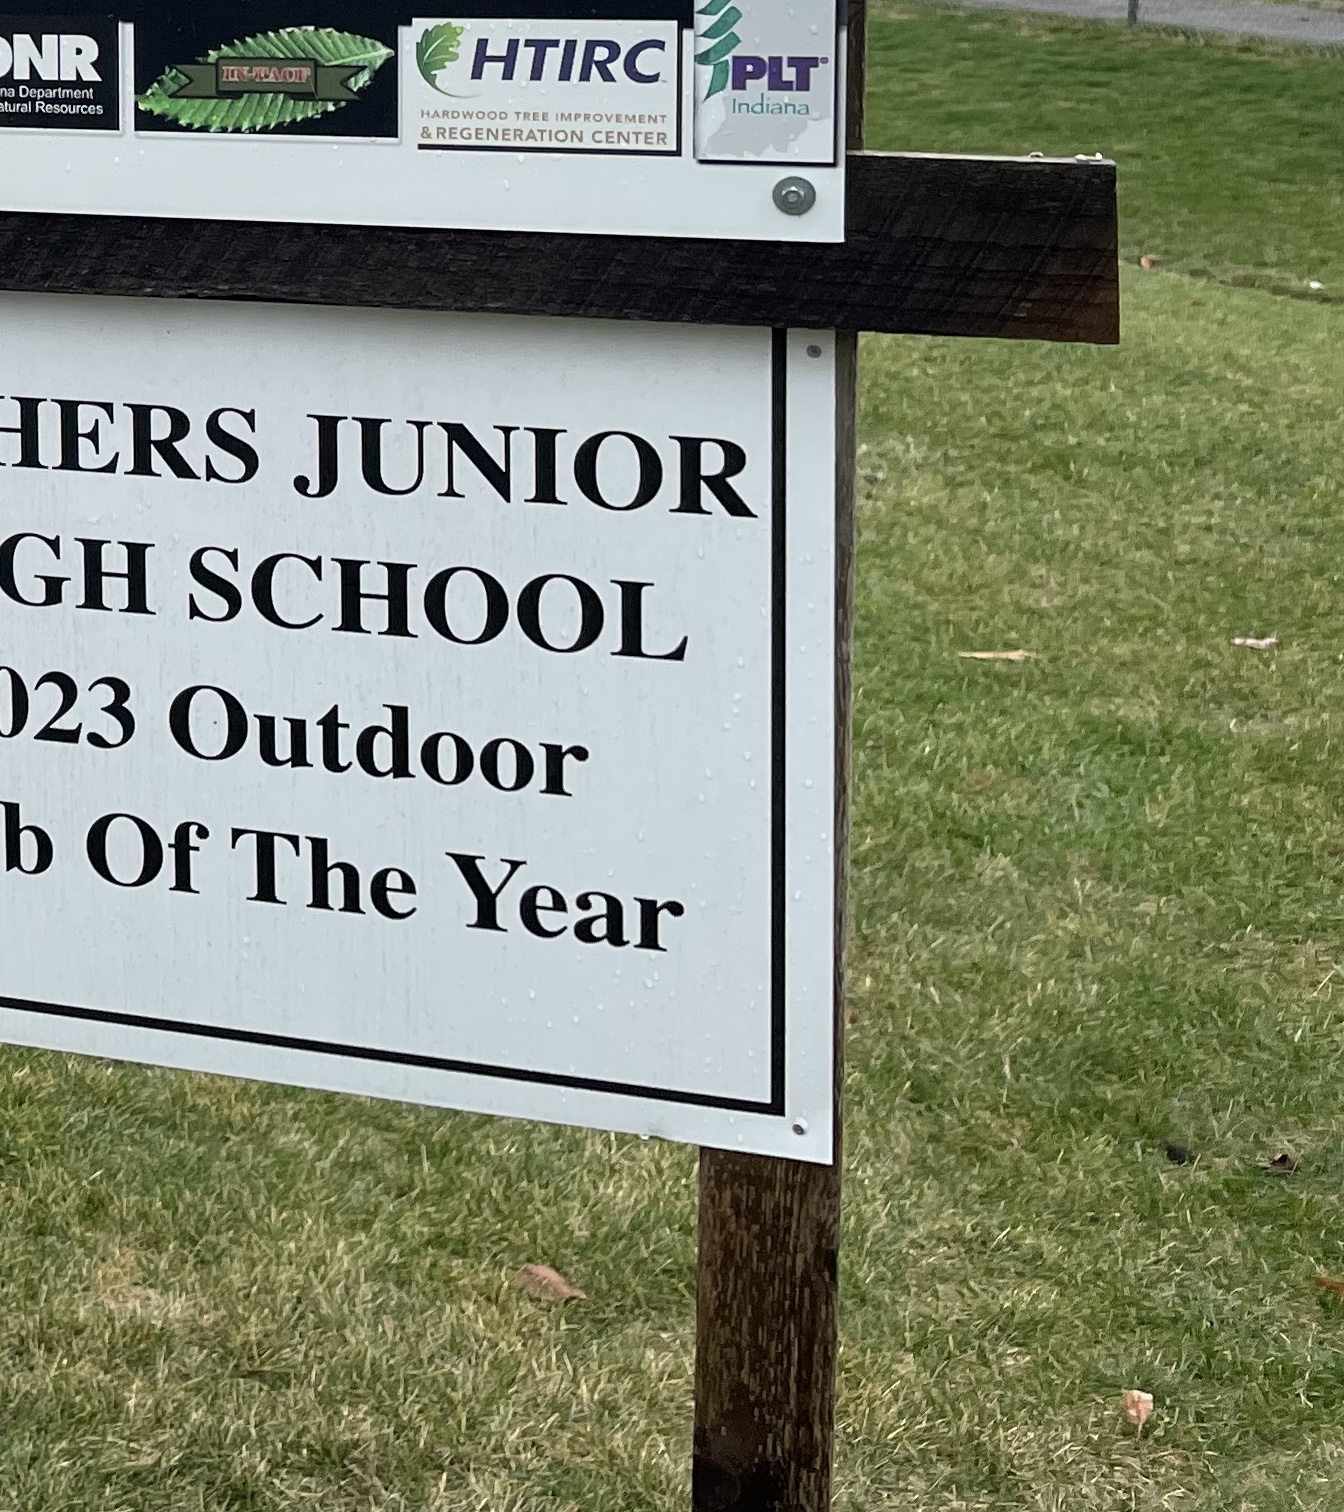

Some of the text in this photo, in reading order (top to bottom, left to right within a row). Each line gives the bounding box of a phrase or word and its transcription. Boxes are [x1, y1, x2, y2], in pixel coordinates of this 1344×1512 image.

[470, 37, 667, 84] HTIRC
[731, 55, 820, 92] PLT
[18, 85, 94, 100] Department
[34, 101, 104, 115] Resources
[732, 92, 810, 115] Indiana
[420, 109, 668, 124] HARDWOOD TREE IMPROVEMENT
[420, 126, 668, 146] & REGENERATION CENTER
[292, 411, 759, 520] JUNIOR
[187, 544, 691, 665] SCHOOL
[167, 681, 591, 799] Outdoor
[86, 811, 212, 895] Of
[230, 825, 420, 922] The
[444, 850, 686, 955] Year
